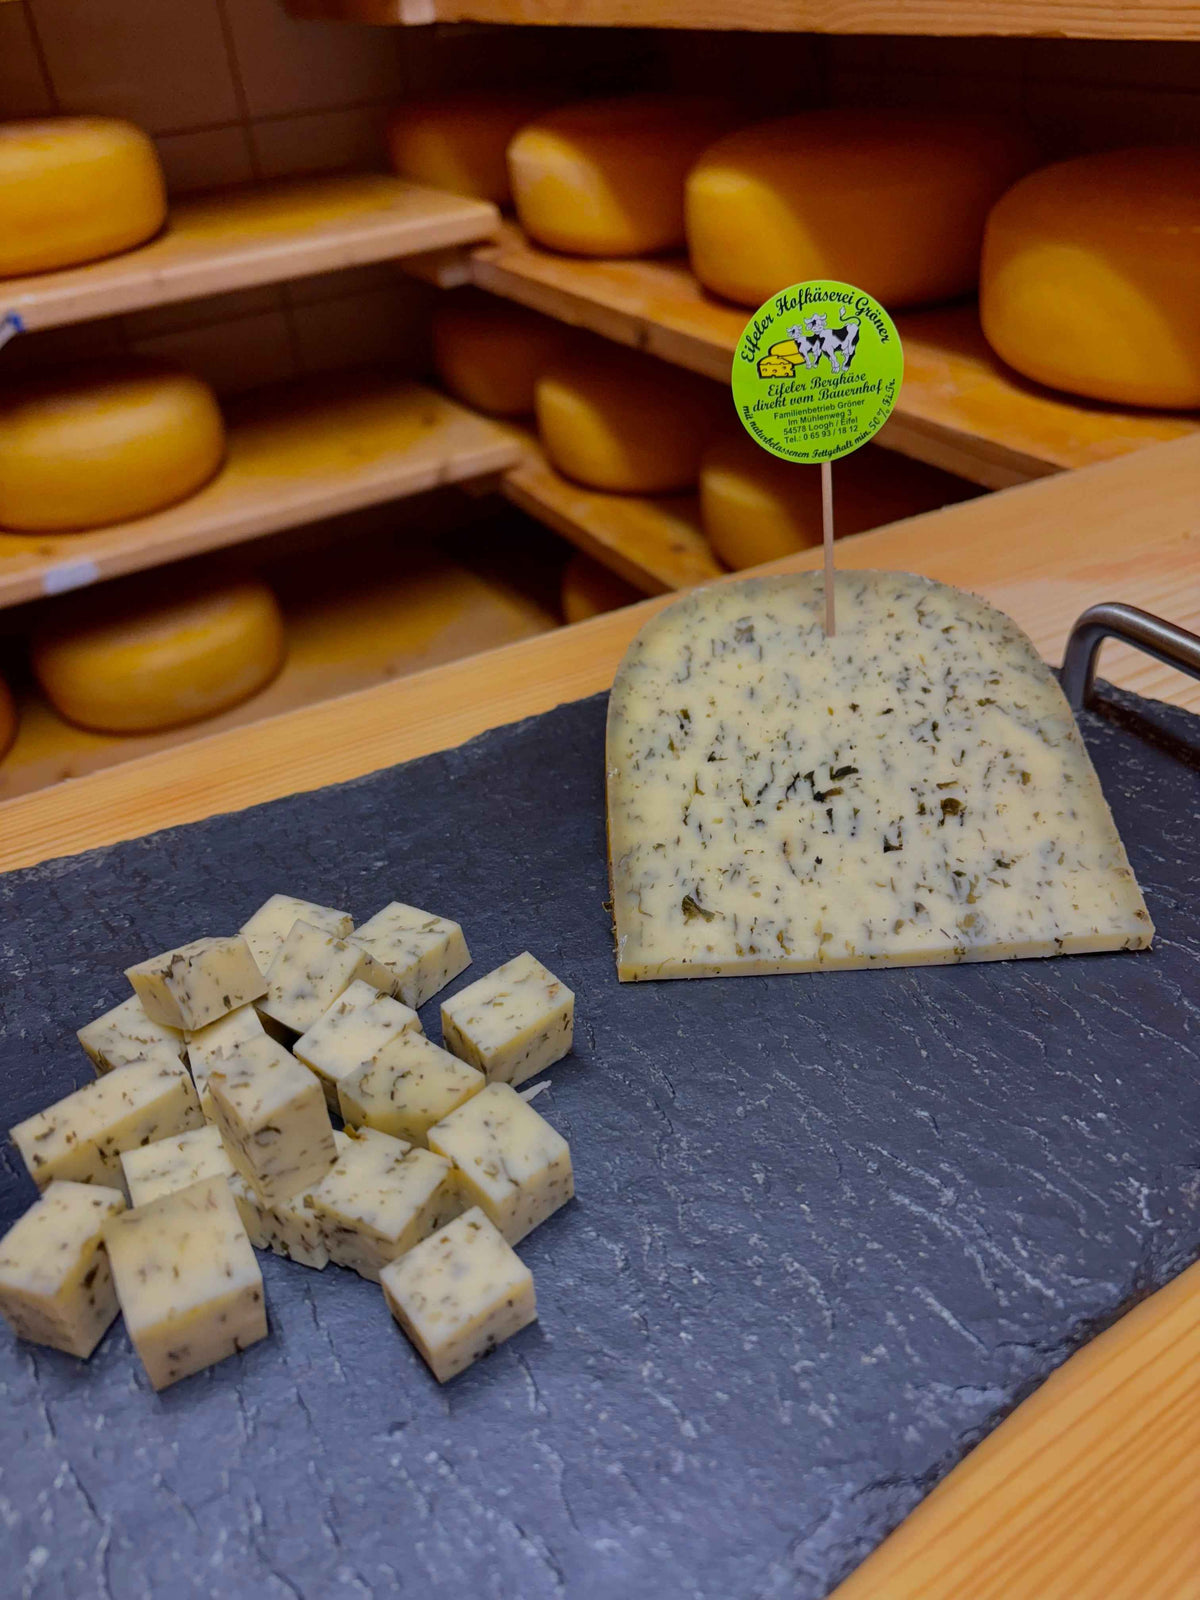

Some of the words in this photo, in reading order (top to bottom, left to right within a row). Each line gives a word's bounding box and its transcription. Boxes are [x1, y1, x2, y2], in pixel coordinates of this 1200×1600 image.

[741, 315, 774, 363] Eifeler
[776, 287, 855, 316] Hofkäserei
[855, 297, 890, 344] Gröner
[752, 398, 786, 412] direkt
[790, 395, 813, 405] vom
[818, 379, 883, 400] Bauernhof
[768, 383, 806, 397] Eifeler
[810, 373, 866, 390] Bergkäse
[774, 404, 835, 419] Familienbetrieb
[837, 399, 865, 409] Gröner
[742, 406, 752, 421] mit
[750, 421, 809, 458] naturbelassenem
[812, 442, 853, 458] Fettgehalt
[854, 430, 871, 445] min.
[869, 417, 881, 430] 50
[878, 408, 890, 419] %
[783, 426, 806, 435] 54578
[809, 421, 833, 431] Loogh
[836, 419, 839, 427] /
[841, 417, 857, 425] Eifel
[788, 418, 798, 426] Im
[785, 436, 801, 444] Tel.:
